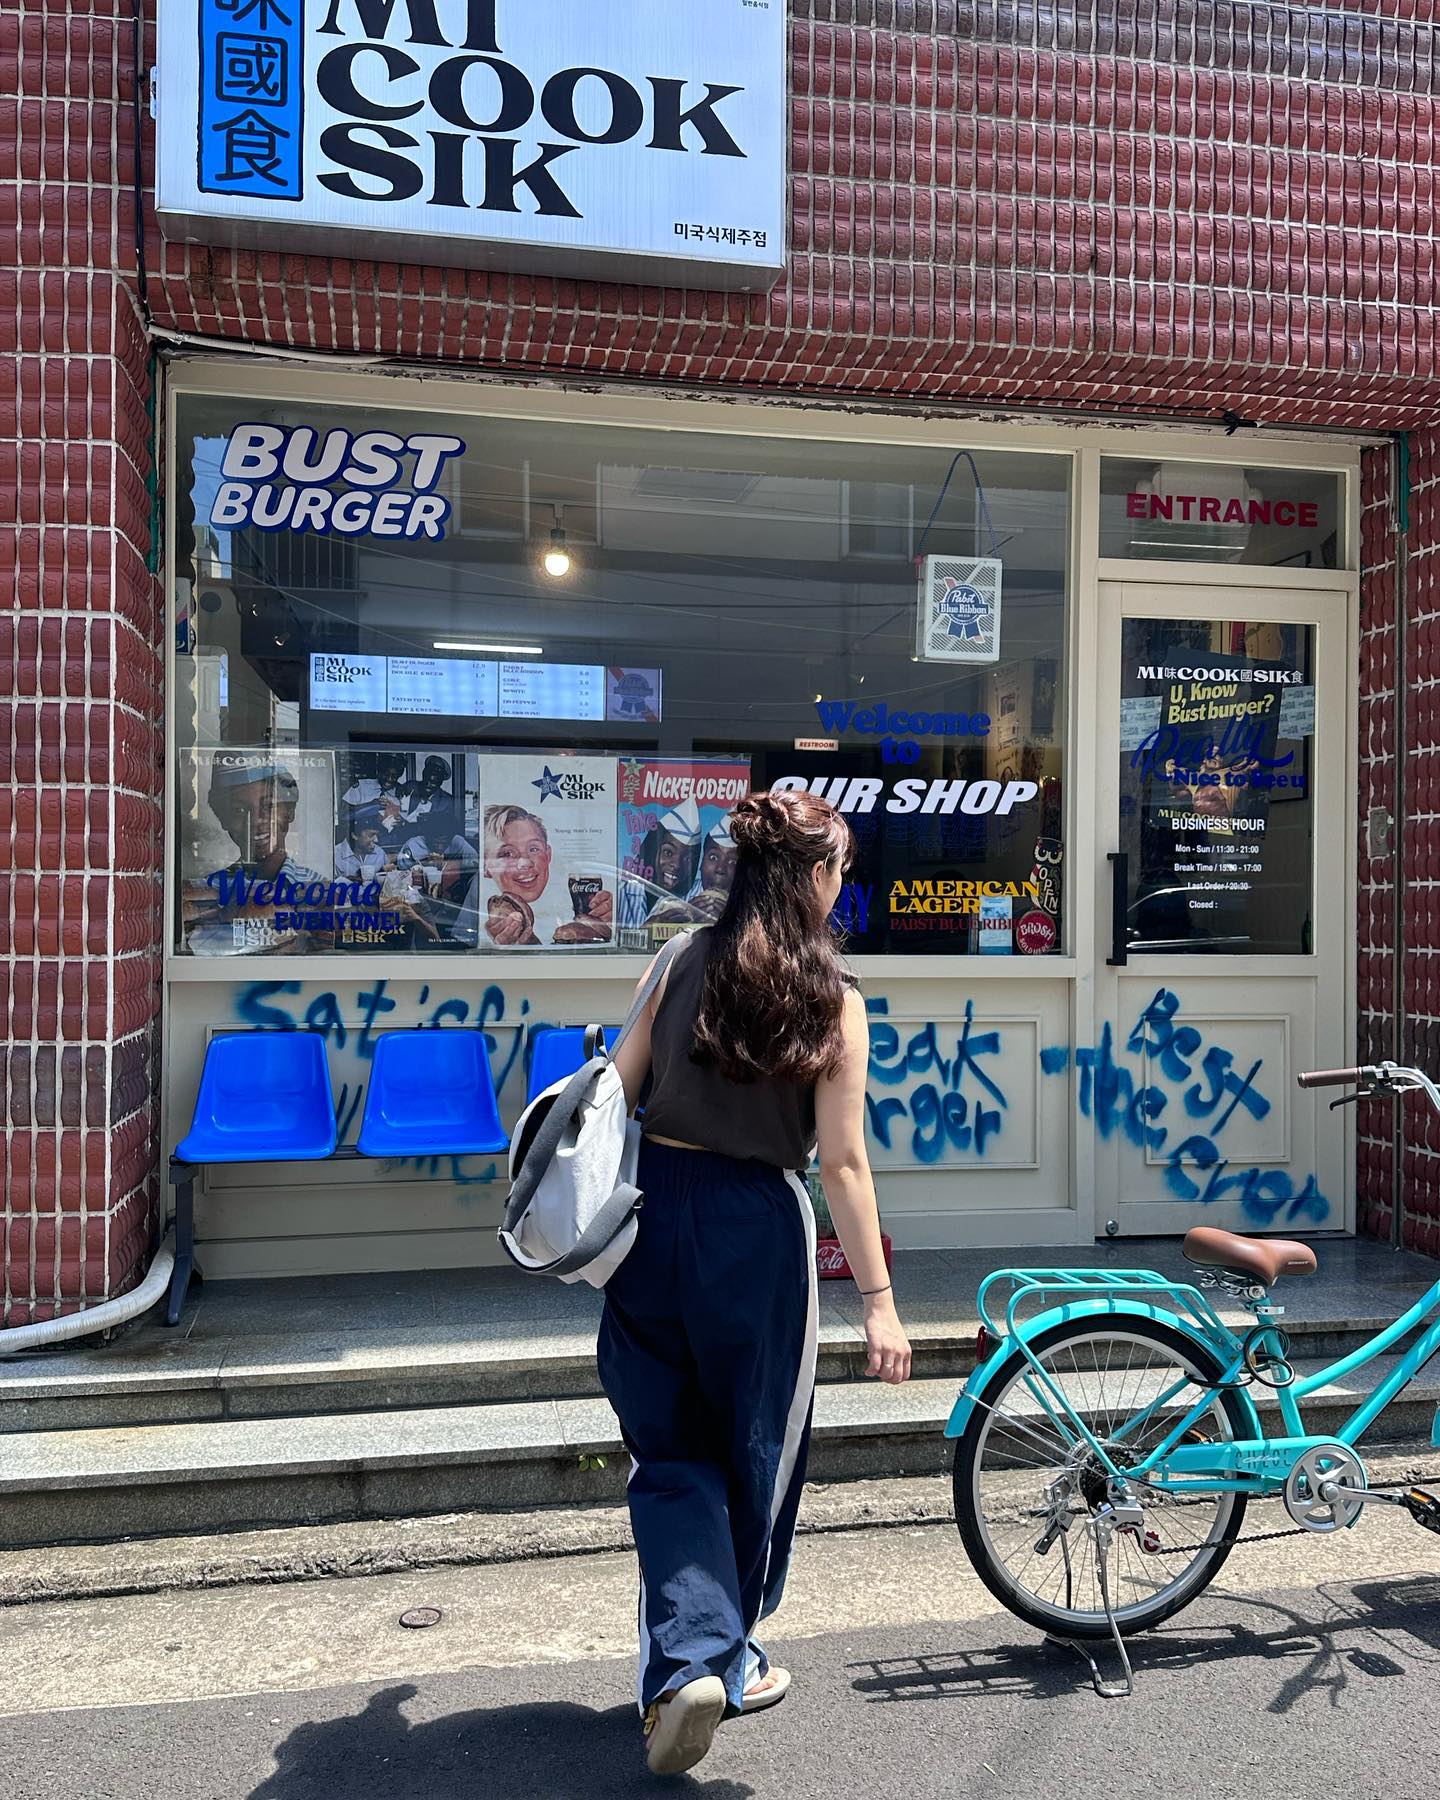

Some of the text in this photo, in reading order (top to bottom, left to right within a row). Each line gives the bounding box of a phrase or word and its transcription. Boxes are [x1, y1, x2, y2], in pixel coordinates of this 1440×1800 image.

[316, 42, 747, 158] COOK
[316, 122, 584, 218] SIK
[673, 222, 768, 249] 미국식제주점
[220, 421, 466, 493] BUST
[209, 482, 450, 541] BURGER
[1126, 492, 1318, 527] ENTRANCE
[951, 589, 976, 604] Pabst
[940, 603, 987, 614] Blue Ribbon
[326, 657, 346, 666] MI
[326, 666, 373, 676] COOK
[326, 674, 354, 683] SIK
[1190, 682, 1238, 701] Know
[815, 700, 991, 736] Welcome
[1167, 703, 1206, 725] Bust
[1207, 693, 1275, 721] burger?
[880, 736, 921, 764] to
[560, 782, 606, 791] COOK
[565, 774, 583, 783] MI
[1172, 768, 1220, 786] Nice
[1224, 771, 1246, 787] to
[1293, 774, 1306, 788] u
[567, 791, 595, 800] SIK
[886, 778, 1039, 815] SHOP
[624, 809, 657, 834] Take
[1171, 818, 1265, 831] BUSINESS HOUR
[632, 836, 641, 851] a
[1175, 844, 1191, 852] Mon
[1196, 845, 1210, 853] Sun
[1216, 845, 1235, 853] 11:30
[1240, 845, 1260, 853] 21:00
[623, 856, 655, 882] Bite
[1174, 863, 1194, 871] Break
[1196, 863, 1213, 872] Time
[1243, 864, 1262, 872] 17:00
[207, 870, 382, 908] Welcome
[888, 879, 1040, 897] AMERICAN
[1038, 866, 1059, 912] OPEN
[1204, 882, 1225, 890] Order
[1229, 882, 1248, 890] 20:30
[888, 897, 981, 914] LAGER
[1189, 900, 1214, 908] Closed
[274, 912, 400, 931] EVERYONE!
[890, 918, 937, 930] PABST
[938, 918, 979, 930] BLUE
